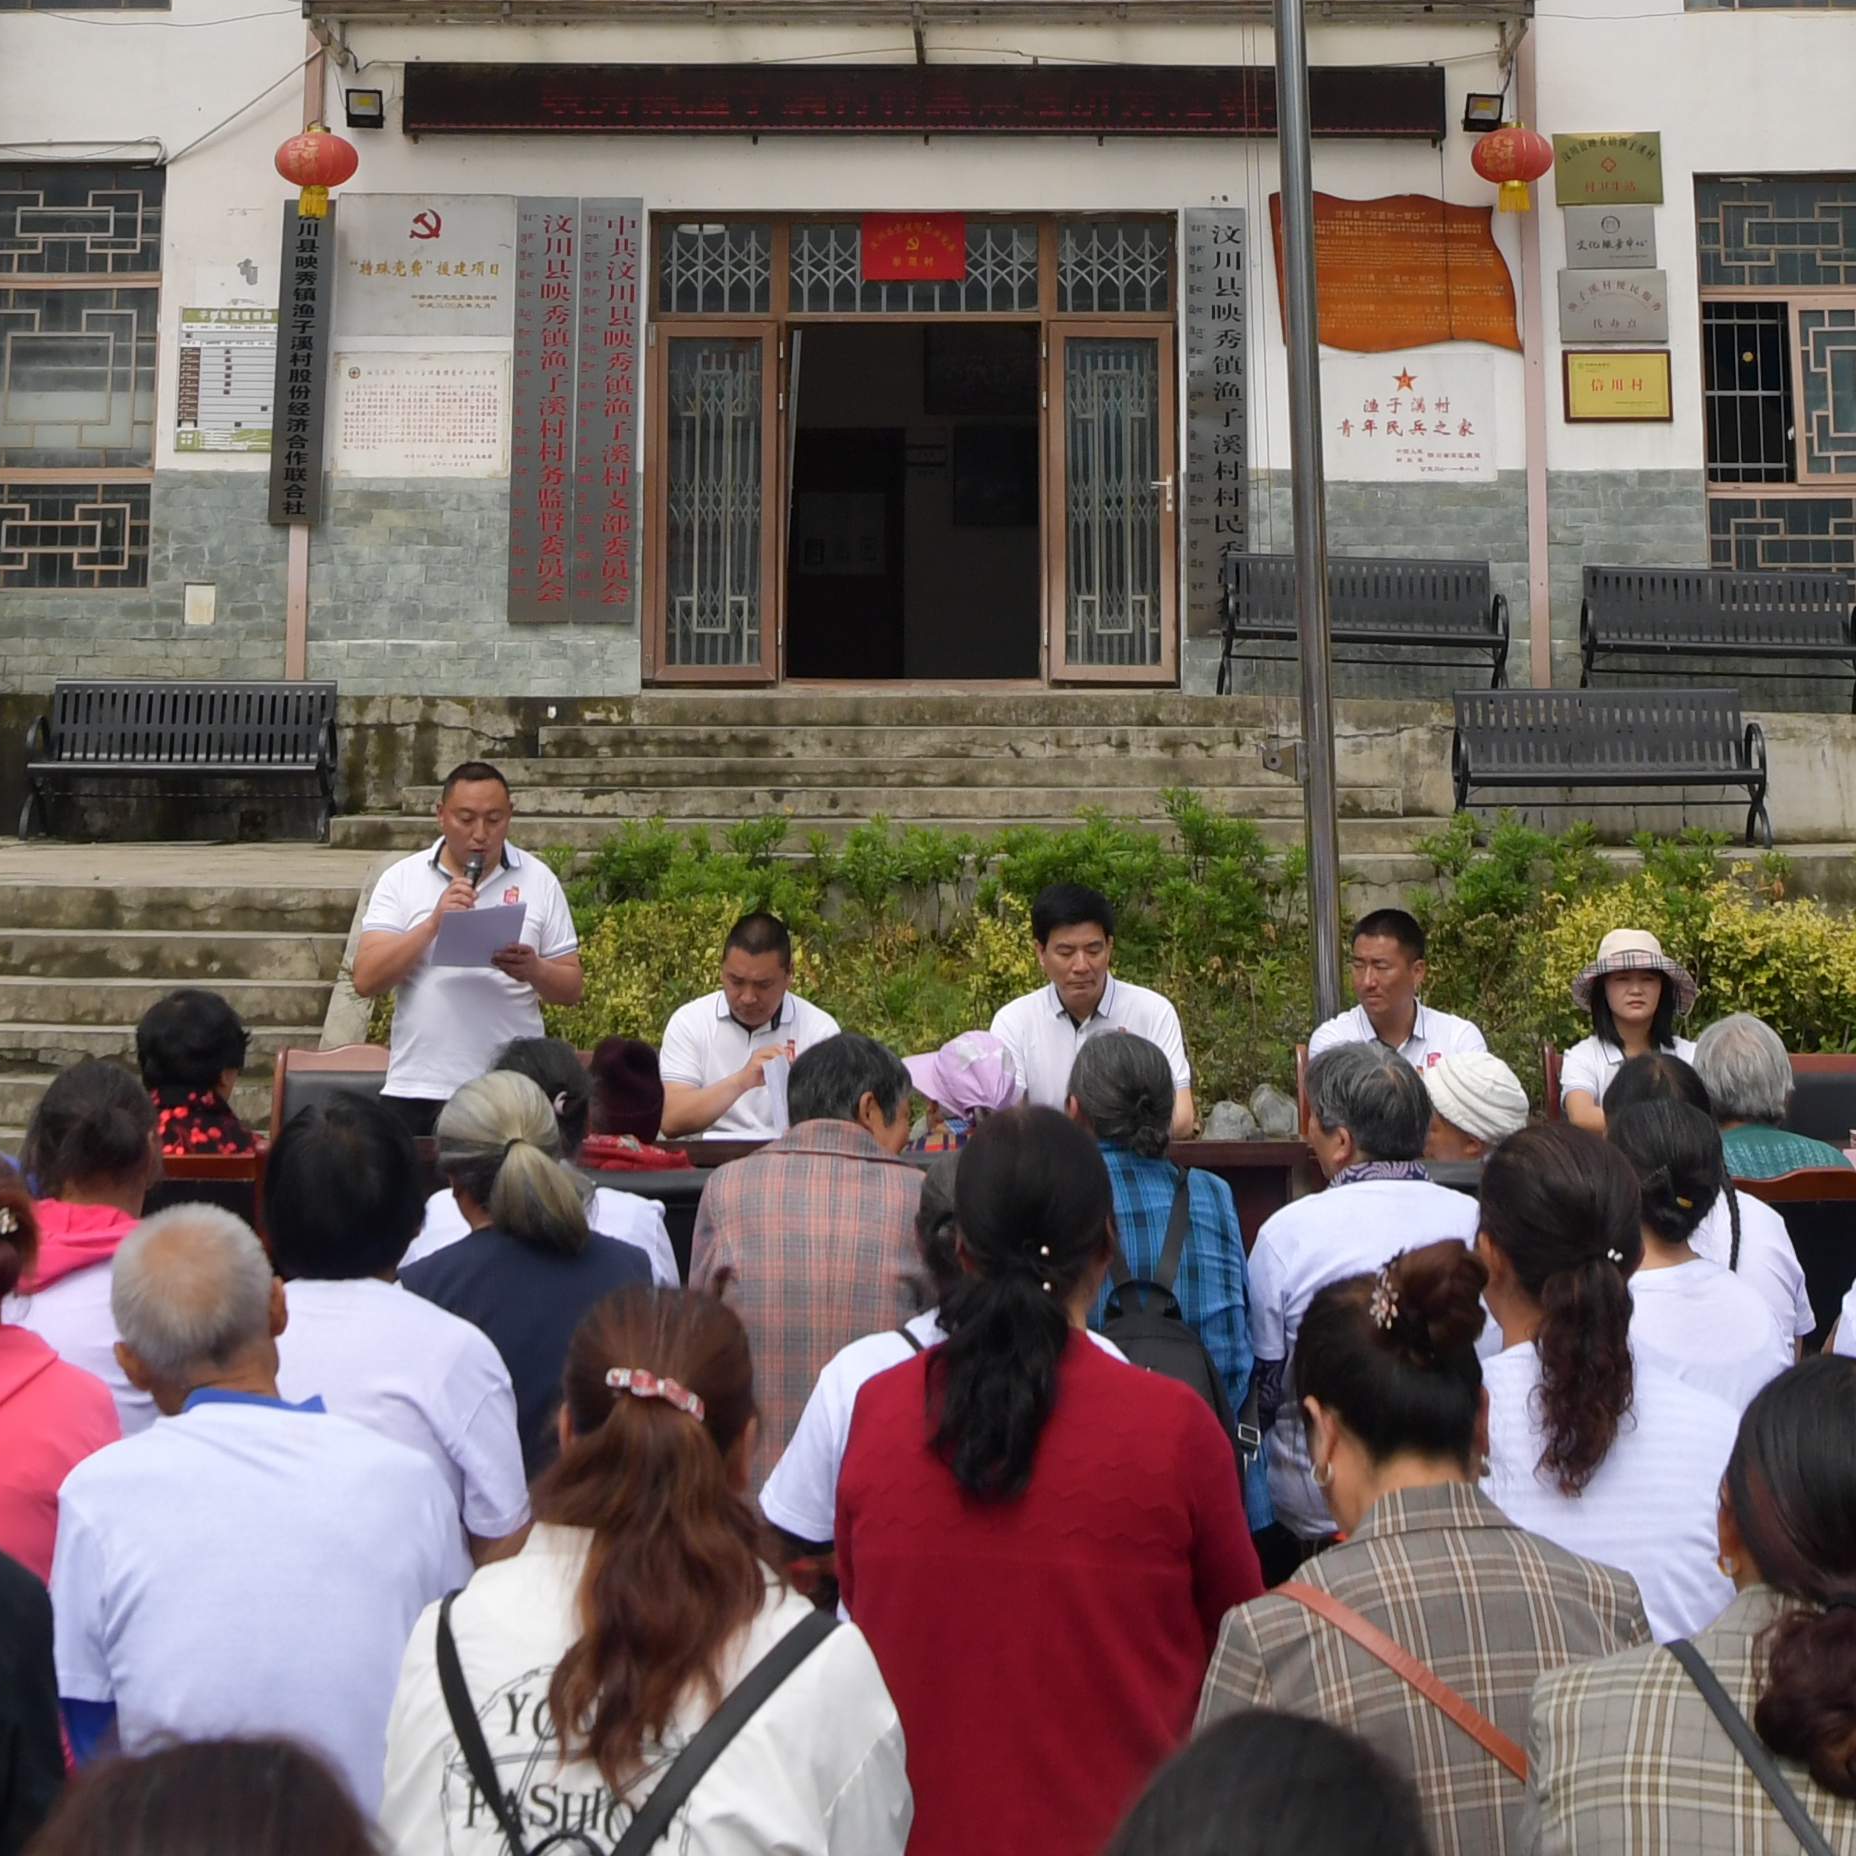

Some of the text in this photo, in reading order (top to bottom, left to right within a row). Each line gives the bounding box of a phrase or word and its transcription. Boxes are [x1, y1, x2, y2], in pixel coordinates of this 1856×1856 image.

[537, 214, 573, 603] 汶川县映秀镇渔子溪村村务监督委员会
[601, 215, 637, 605] 中共汶川县映秀镇渔子溪村支部委员会
[1337, 418, 1475, 438] 青年民兵之家
